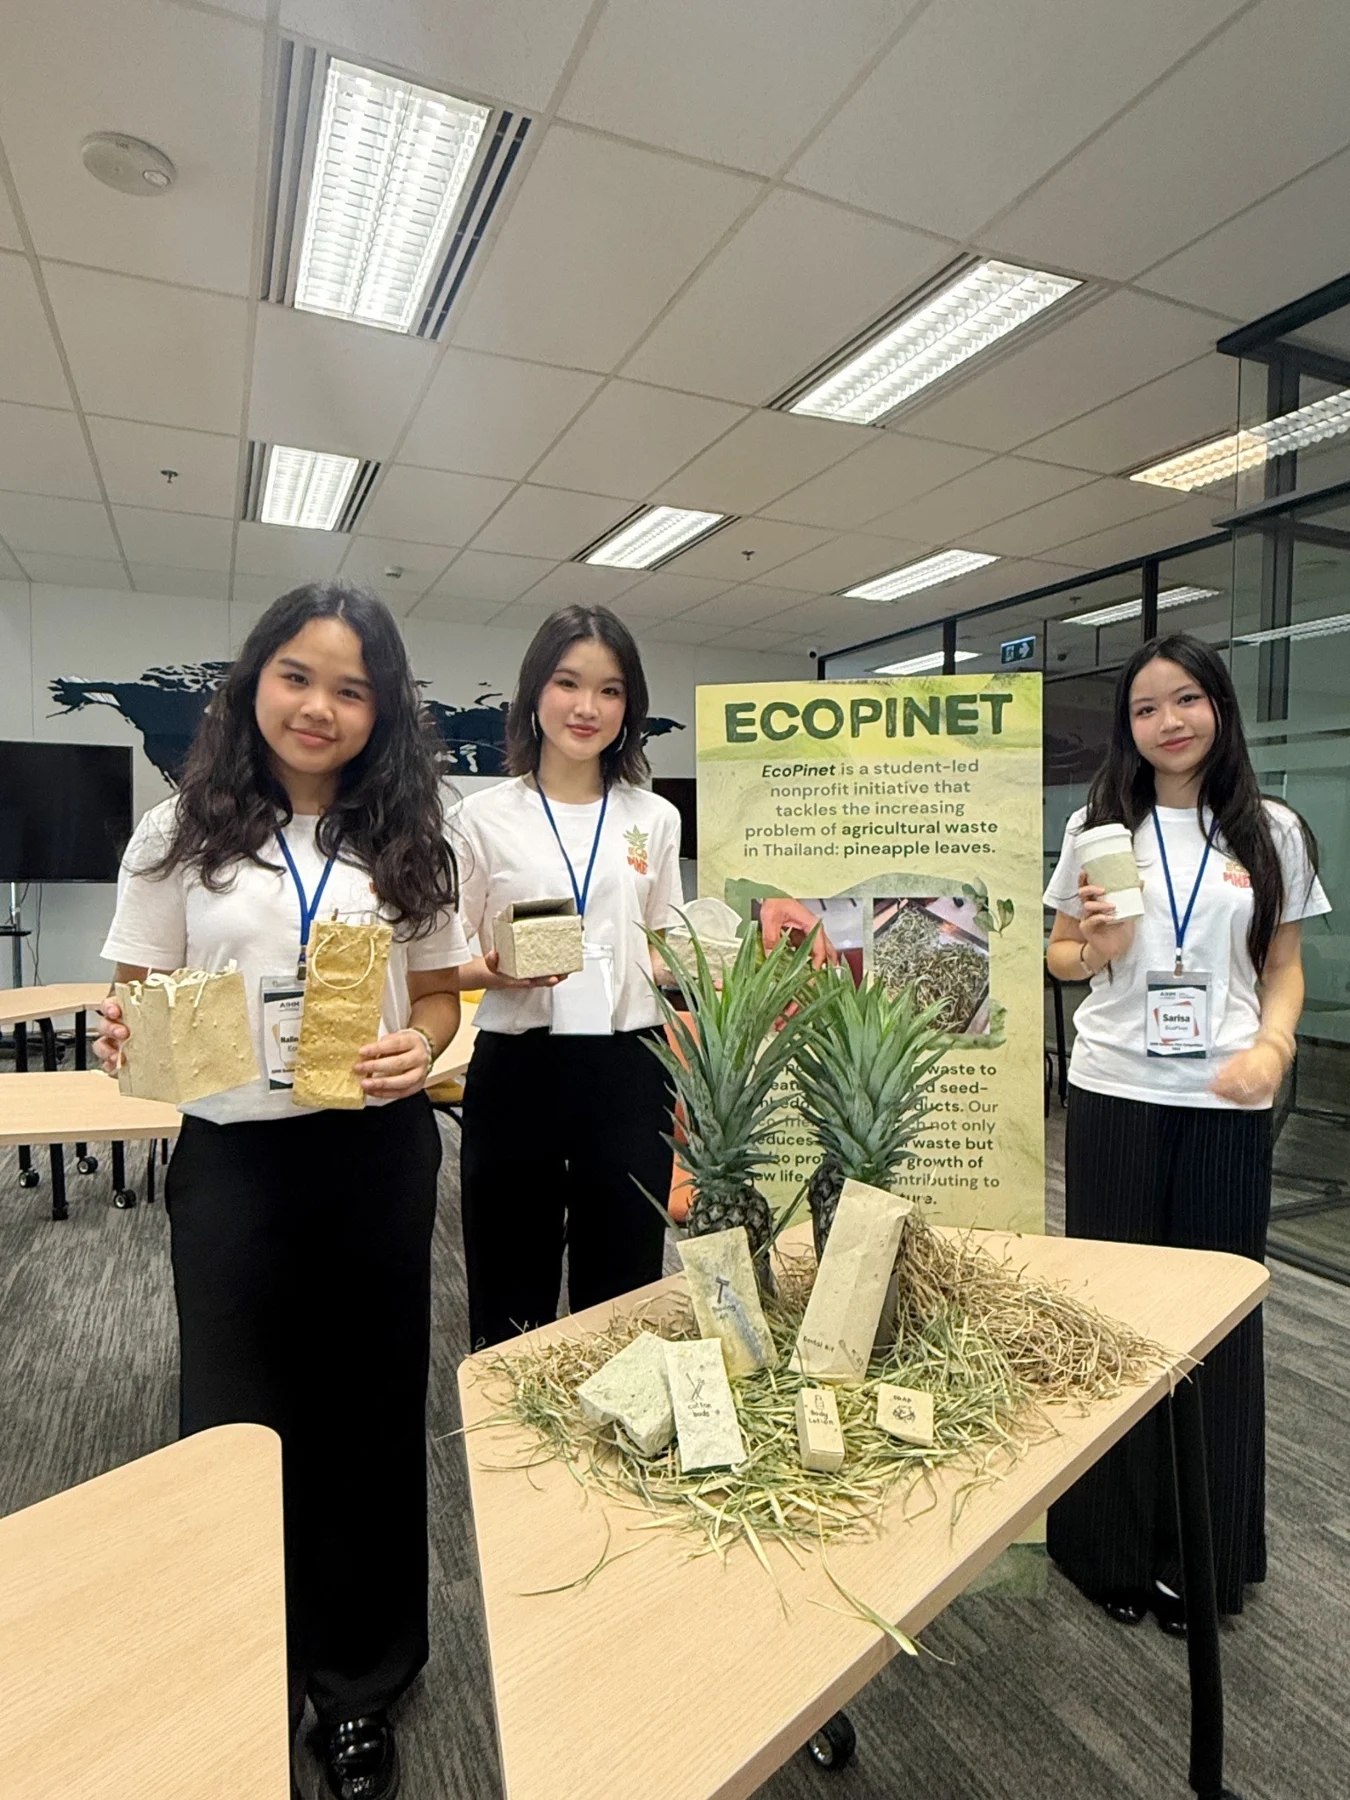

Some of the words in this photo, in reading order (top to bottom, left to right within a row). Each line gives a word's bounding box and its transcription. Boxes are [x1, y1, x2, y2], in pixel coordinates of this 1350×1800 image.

[725, 693, 1013, 744] ECOPINET
[761, 763, 836, 779] EcoPinet
[841, 762, 854, 776] is
[859, 765, 869, 775] a
[873, 759, 979, 775] student-led
[770, 782, 849, 798] nonprofit
[854, 781, 929, 795] initiative
[934, 780, 970, 794] that
[776, 803, 837, 817] tackles
[842, 802, 870, 816] the
[875, 801, 965, 817] increasing
[745, 824, 816, 840] problem
[820, 823, 838, 836] of
[841, 821, 940, 839] agricultural
[945, 822, 998, 834] waste
[744, 843, 758, 857] in
[763, 842, 839, 857] Thailand:
[843, 842, 930, 858] pineapple
[935, 840, 995, 854] leaves.
[1162, 1014, 1190, 1022] Sarisa
[927, 1065, 975, 1075] waste
[979, 1064, 997, 1075] to
[968, 1100, 999, 1113] Our
[930, 1120, 957, 1131] not
[961, 1119, 996, 1134] only
[757, 1133, 813, 1146] educes
[912, 1138, 961, 1149] waste
[966, 1137, 994, 1150] but
[906, 1155, 963, 1171] growth
[968, 1156, 984, 1169] of
[984, 1176, 1000, 1188] to
